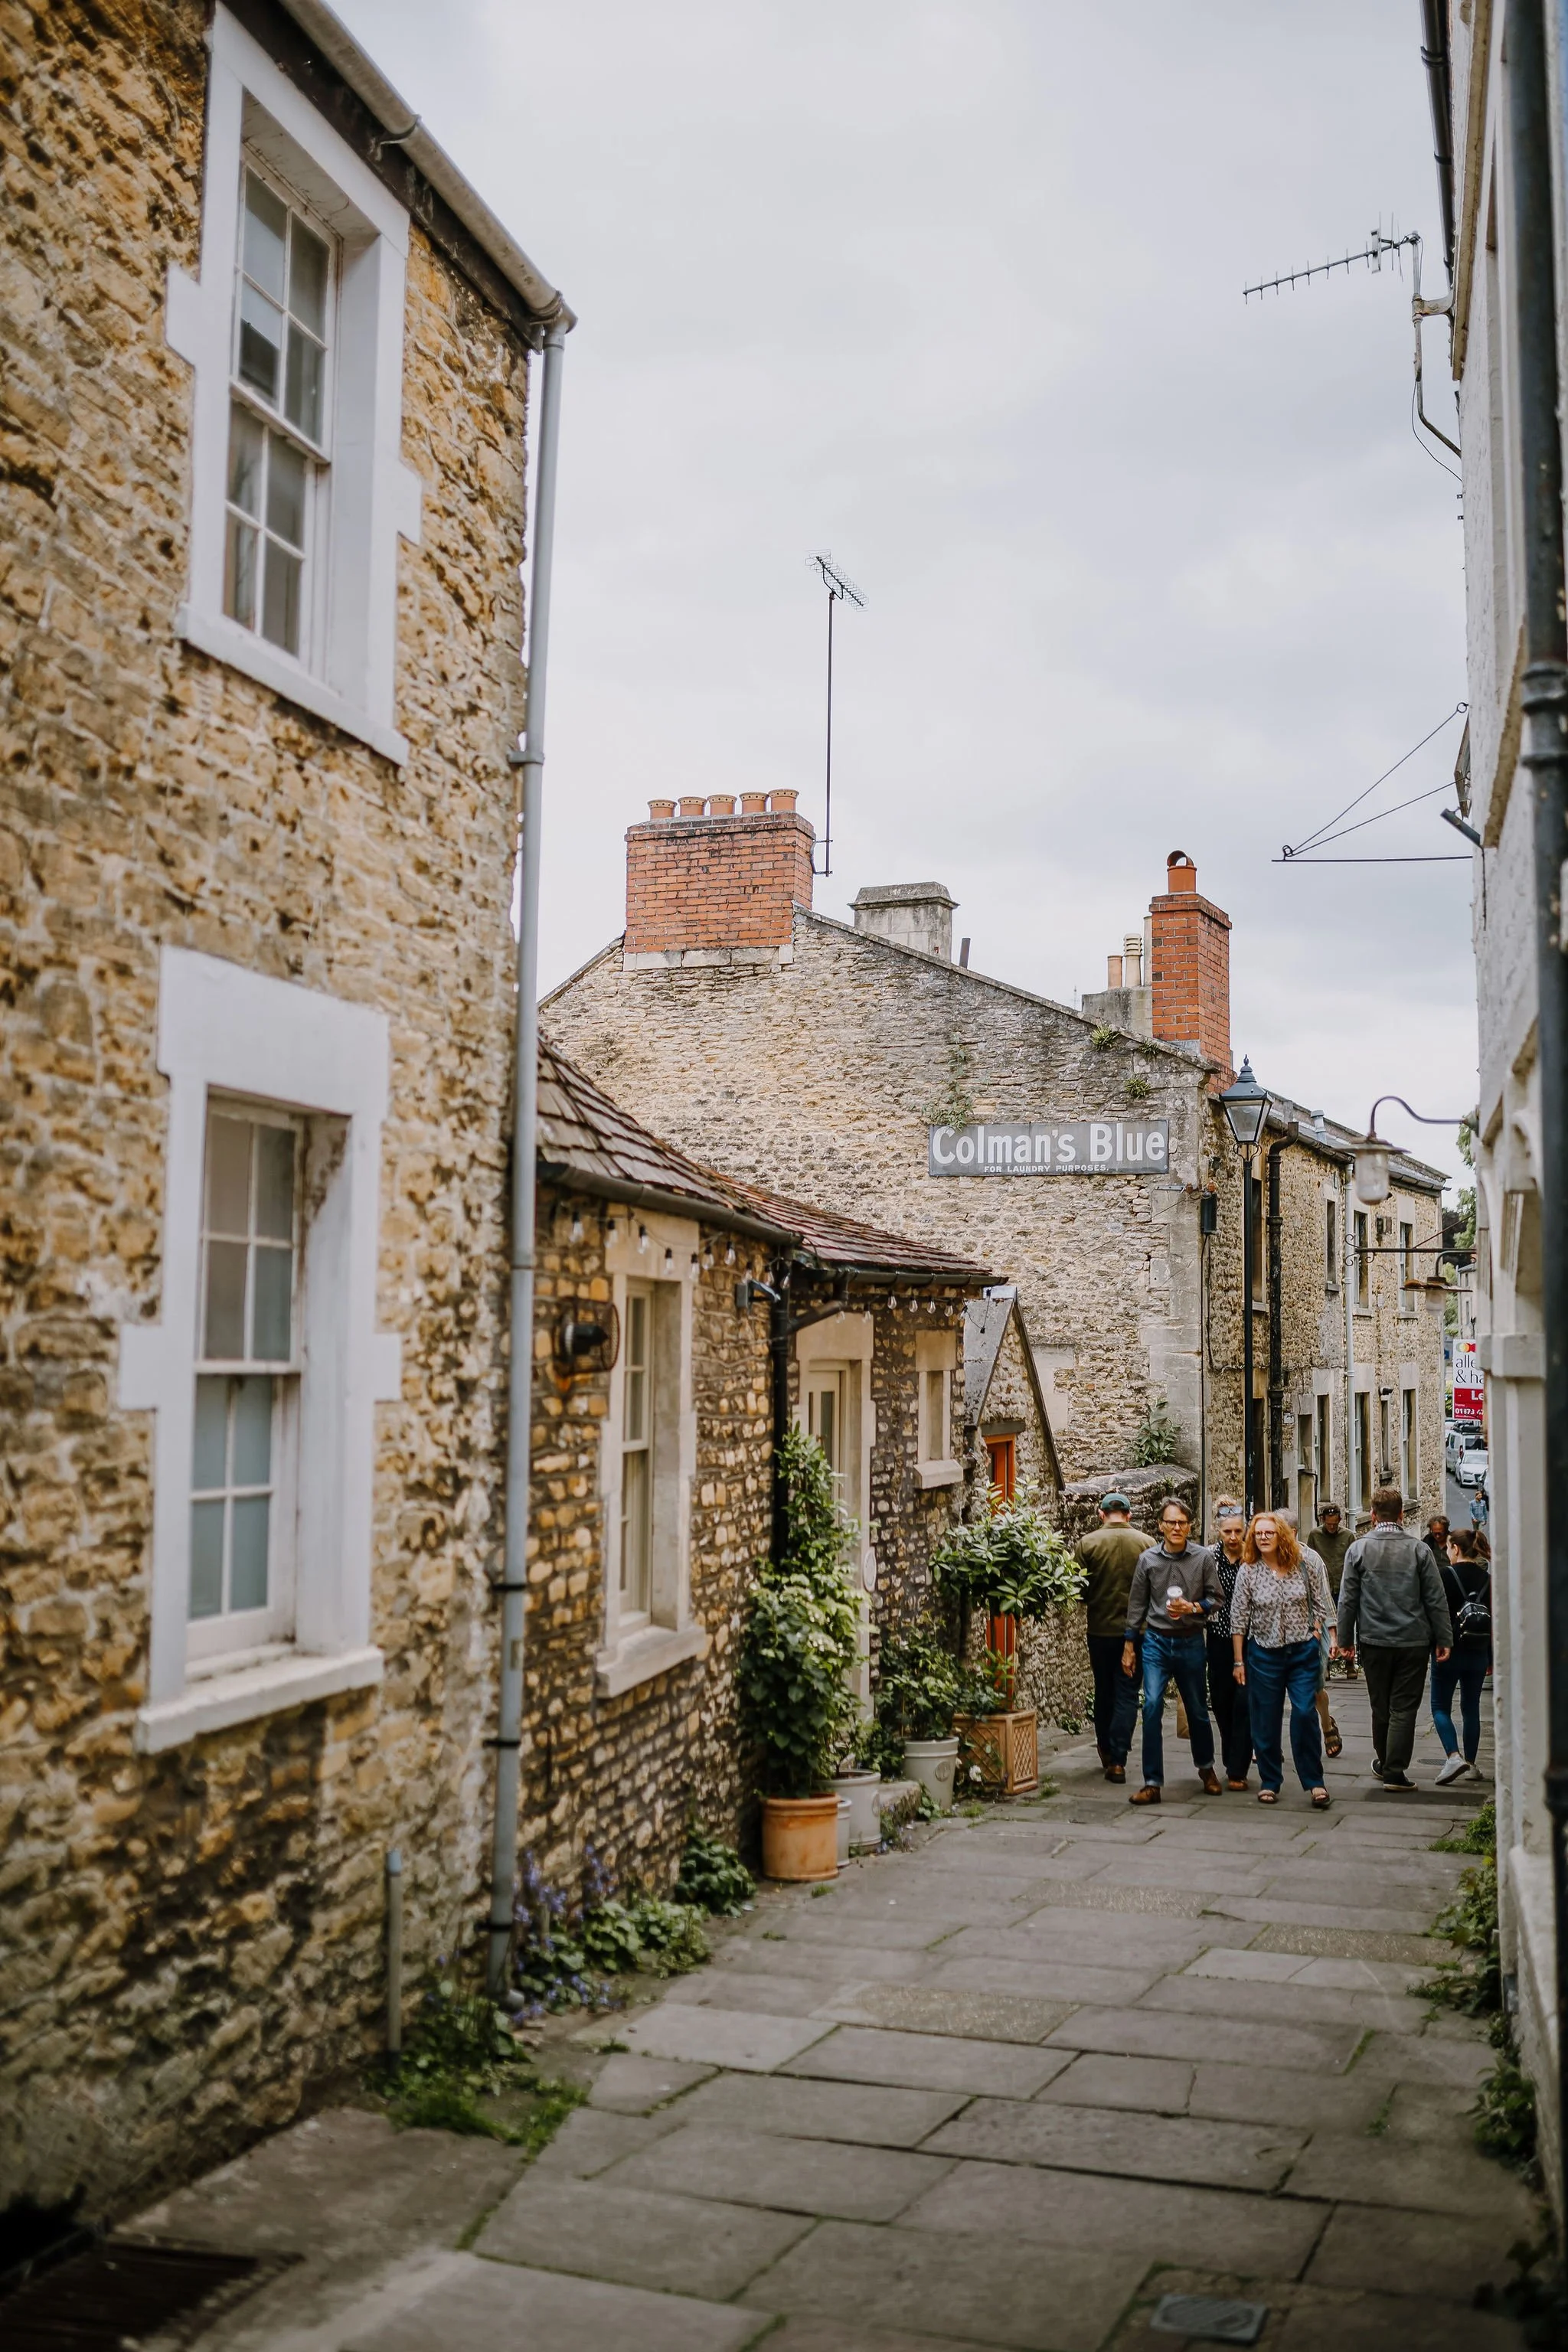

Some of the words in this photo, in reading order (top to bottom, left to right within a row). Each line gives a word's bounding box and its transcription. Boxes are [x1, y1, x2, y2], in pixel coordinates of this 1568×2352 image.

[933, 1126, 1076, 1165] Colman's
[1090, 1123, 1165, 1162] Blue
[1455, 1370, 1466, 1383] &
